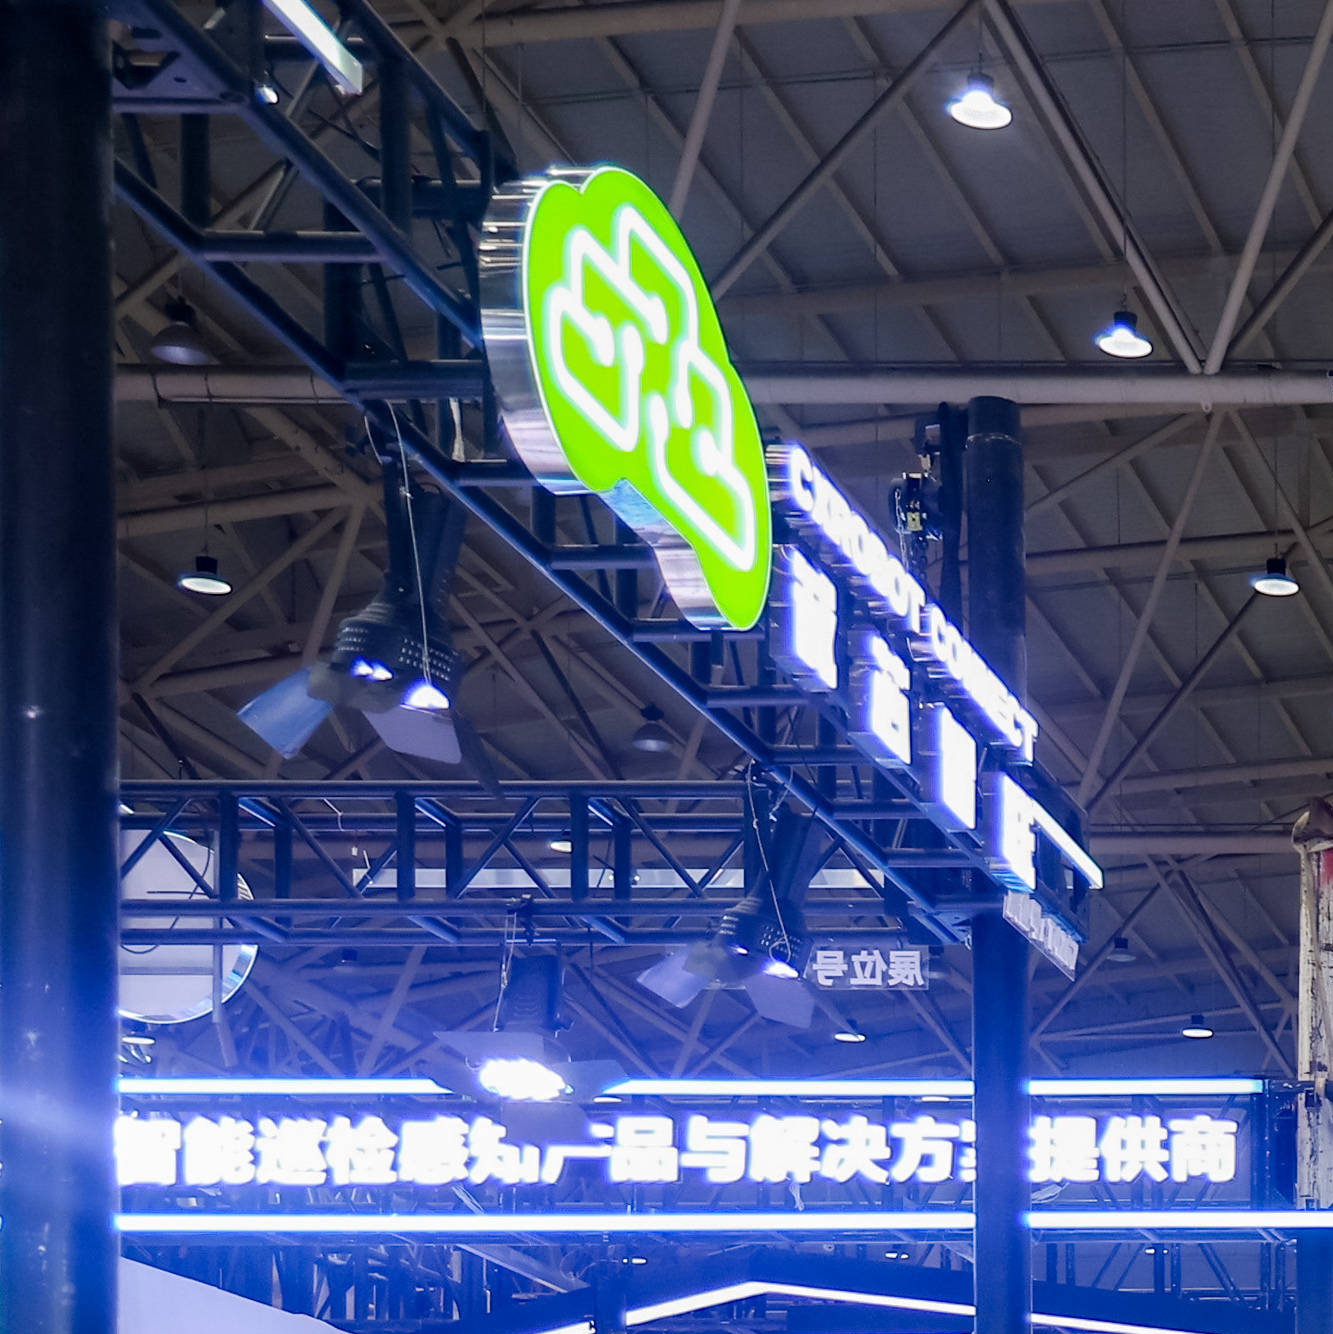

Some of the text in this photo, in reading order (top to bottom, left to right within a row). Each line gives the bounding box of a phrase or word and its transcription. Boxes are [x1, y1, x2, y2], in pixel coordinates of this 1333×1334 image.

[113, 1114, 1239, 1187] 智能巡检感知产品与解决方提供商
